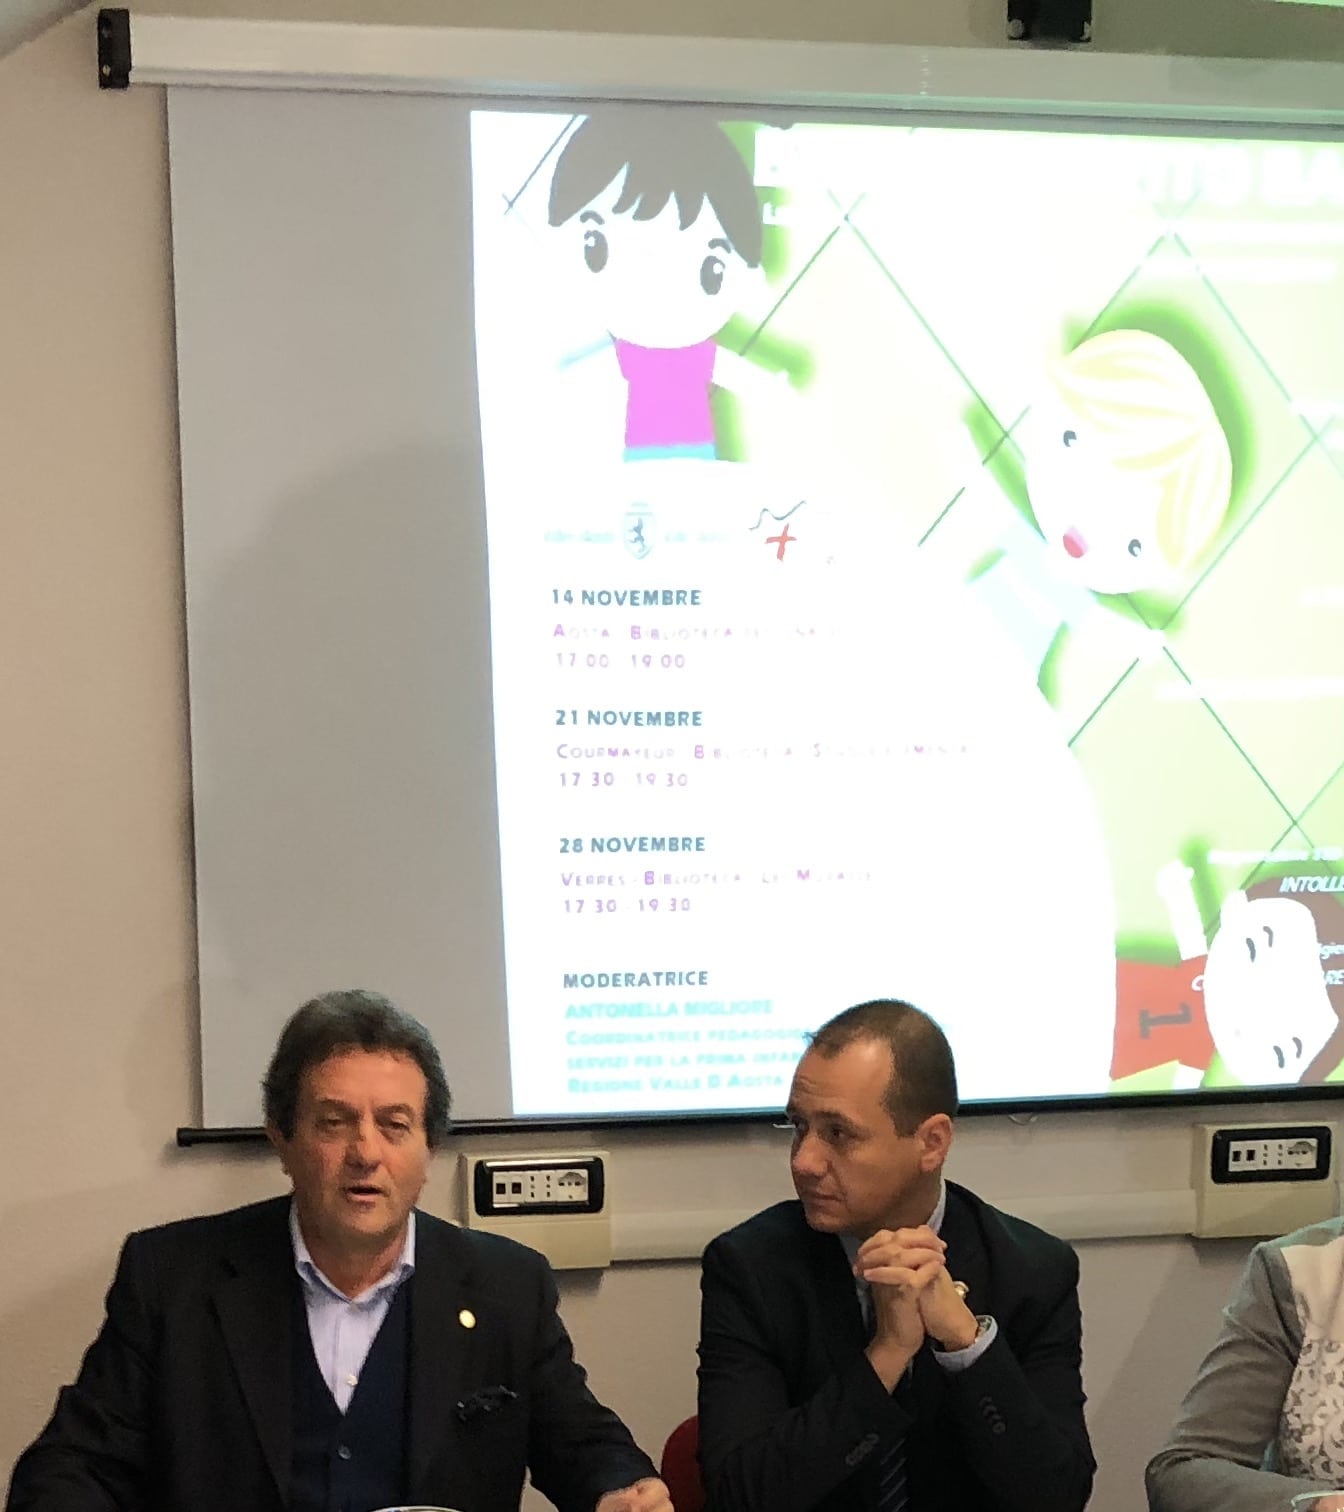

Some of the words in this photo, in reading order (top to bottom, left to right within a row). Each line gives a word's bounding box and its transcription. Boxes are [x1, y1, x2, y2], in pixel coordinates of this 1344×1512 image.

[552, 588, 574, 605] 14
[581, 589, 702, 606] NOVEMBRE
[555, 709, 579, 727] 21
[587, 709, 704, 728] NOVEMBRE
[559, 837, 583, 854] 28
[590, 836, 705, 854] NOVEMBRE
[563, 971, 709, 989] MODERATRICE
